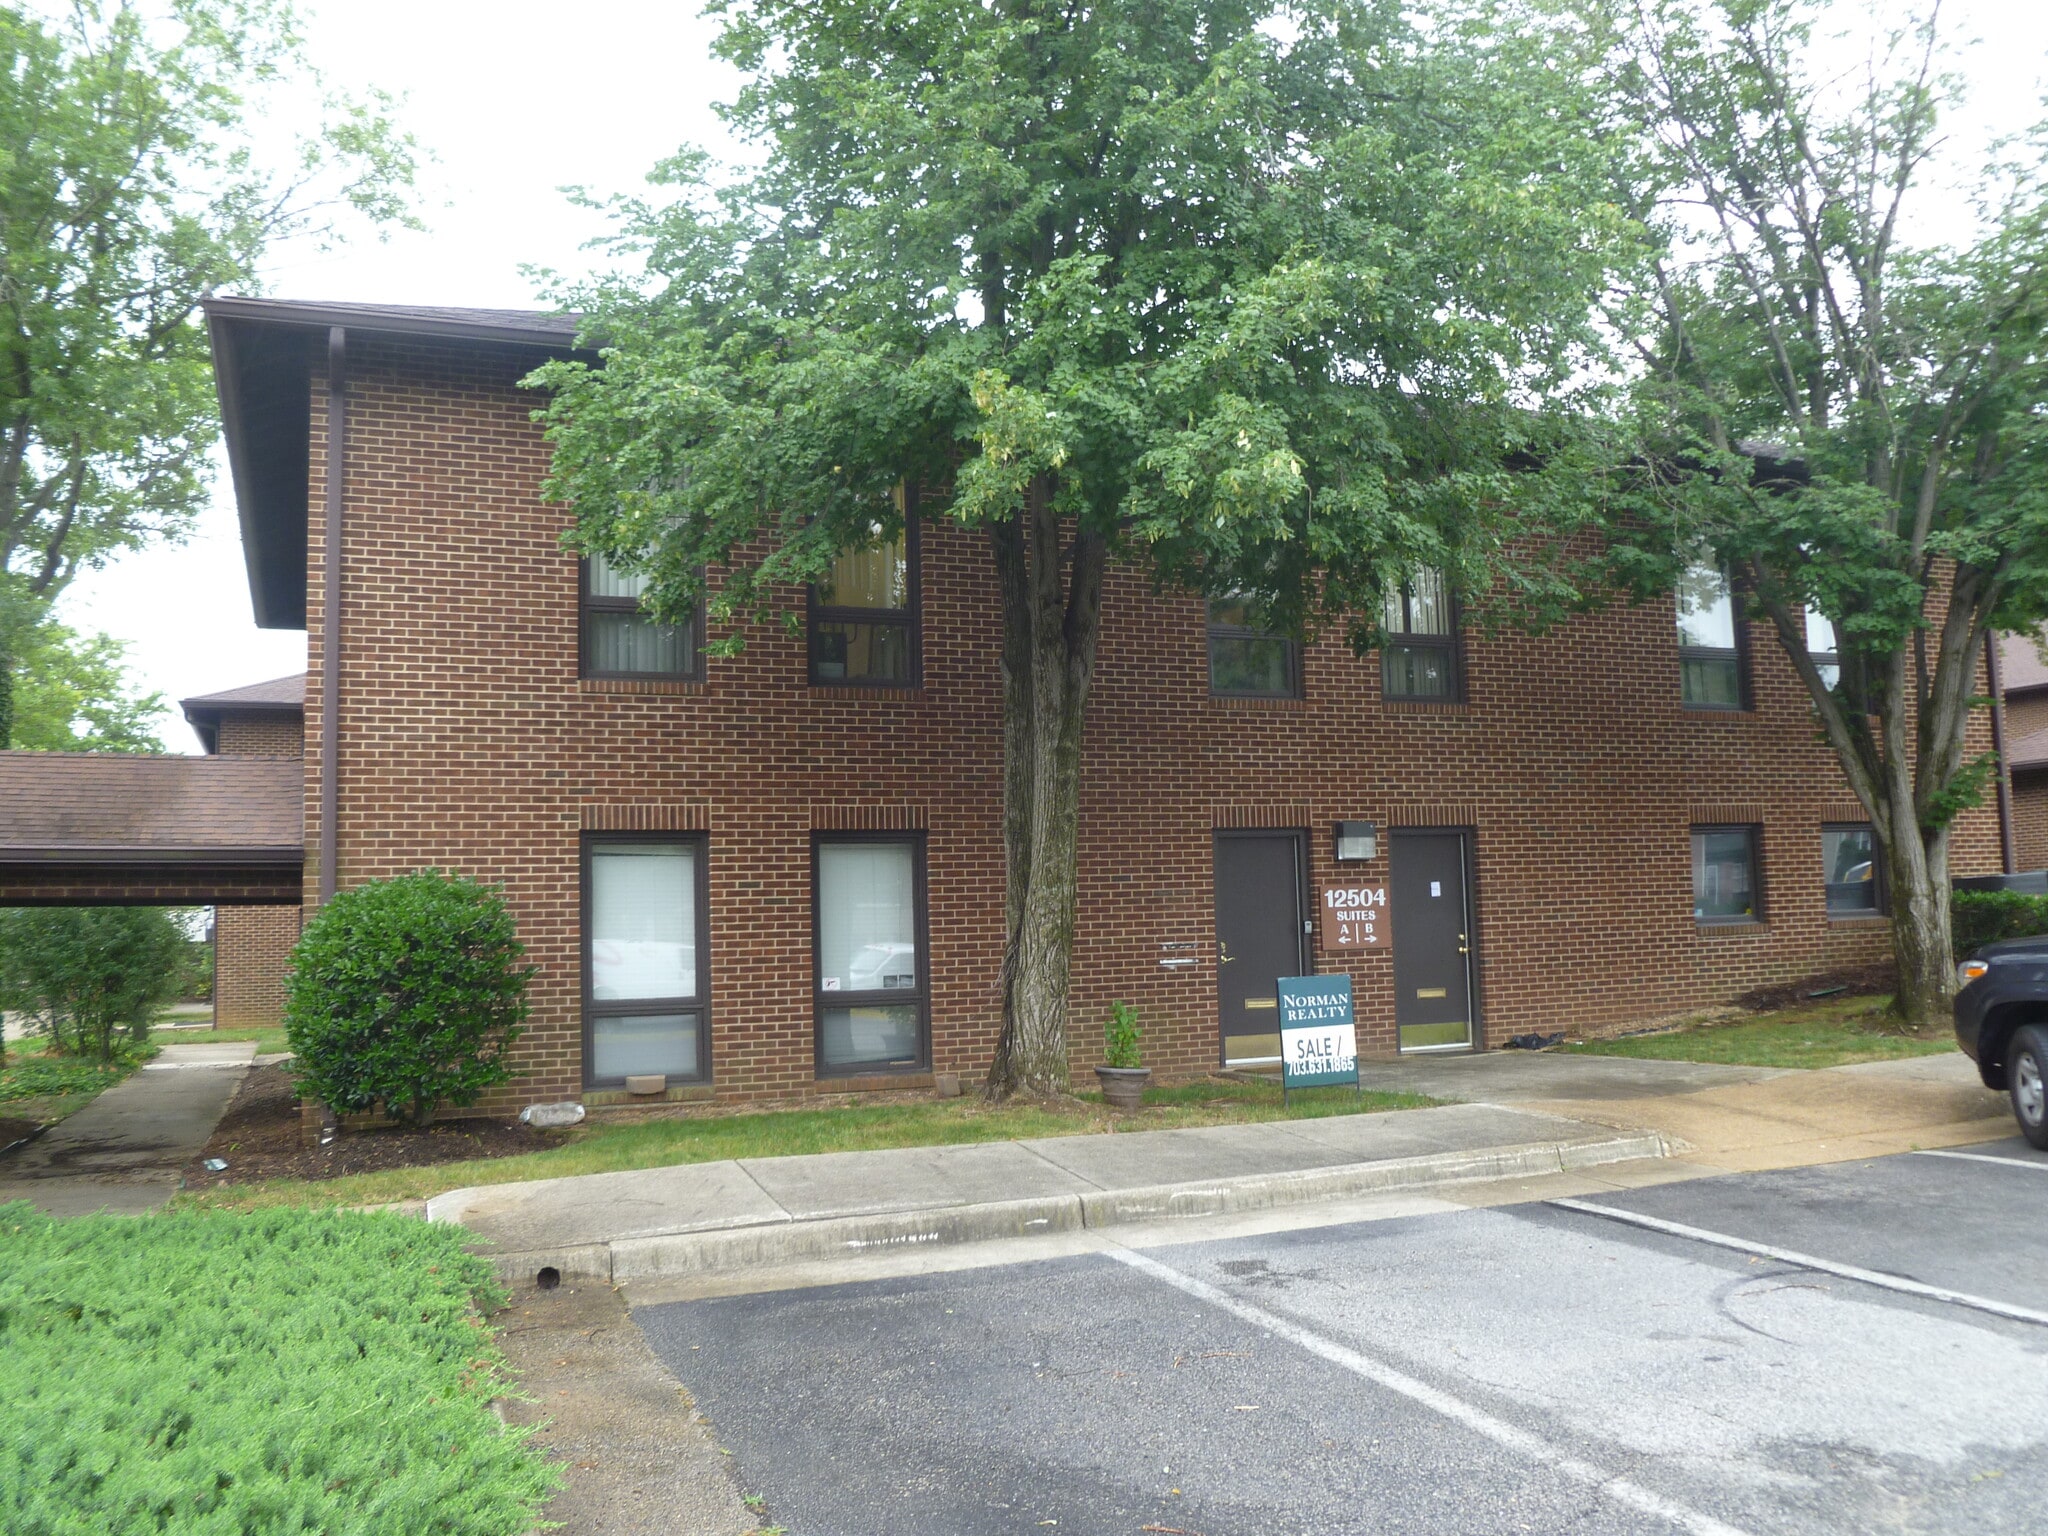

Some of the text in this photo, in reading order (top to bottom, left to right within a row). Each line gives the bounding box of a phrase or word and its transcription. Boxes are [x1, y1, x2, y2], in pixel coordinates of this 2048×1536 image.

[1324, 888, 1386, 908] 12504
[1336, 910, 1376, 921] SUITES
[1340, 924, 1349, 934] A
[1365, 923, 1373, 933] B
[1283, 993, 1349, 1008] NORMAN
[1288, 1006, 1347, 1021] REALTY
[1297, 1037, 1332, 1059] SALE
[1287, 1056, 1355, 1076] 703.631.1865
